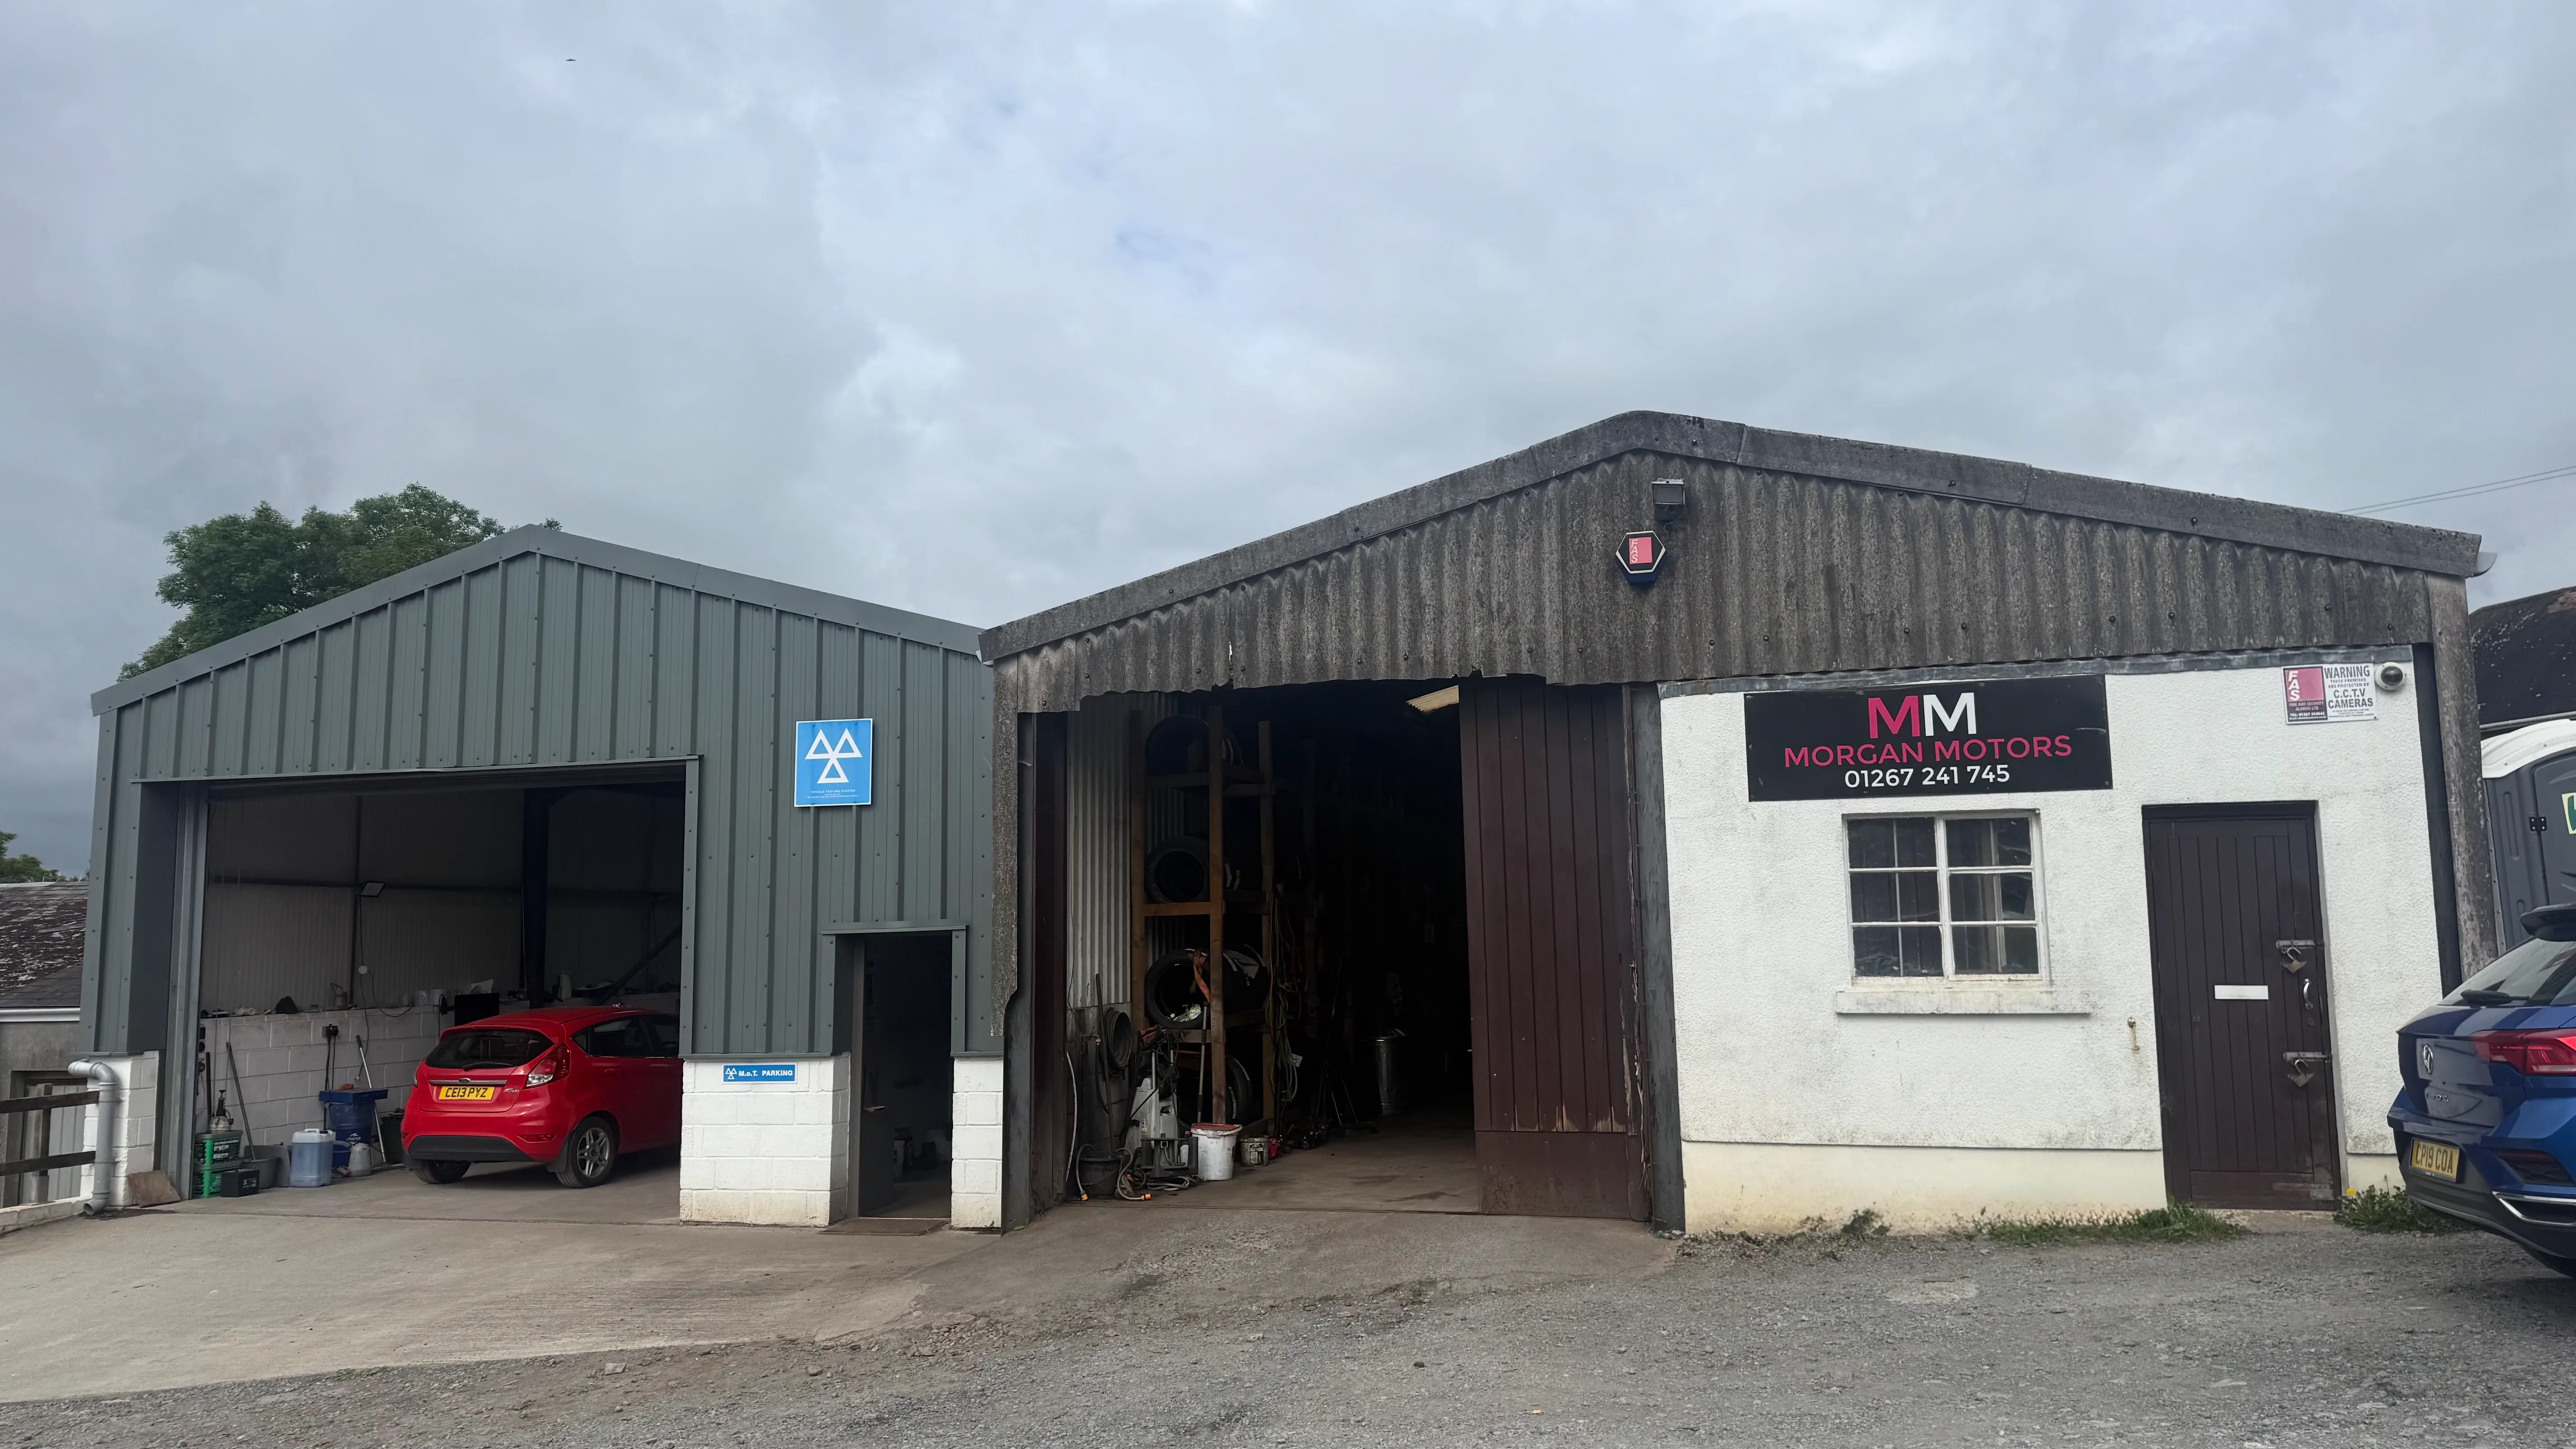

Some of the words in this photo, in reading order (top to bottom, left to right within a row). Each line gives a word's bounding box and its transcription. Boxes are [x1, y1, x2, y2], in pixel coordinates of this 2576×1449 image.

[2324, 665, 2370, 679] WARNING
[2288, 671, 2300, 701] FAS
[2333, 688, 2365, 699] C.C.T.V
[2328, 698, 2373, 708] CAMERAS
[1868, 692, 1977, 739] MM
[1785, 741, 1923, 768] MORGAN
[1935, 735, 2072, 762] MOTORS
[1845, 768, 1914, 788] 01267
[1921, 766, 1959, 786] 241
[1966, 764, 2010, 784] 745
[445, 1087, 466, 1098] CE13
[467, 1087, 488, 1098] PYZ
[2416, 1143, 2434, 1168] CP19
